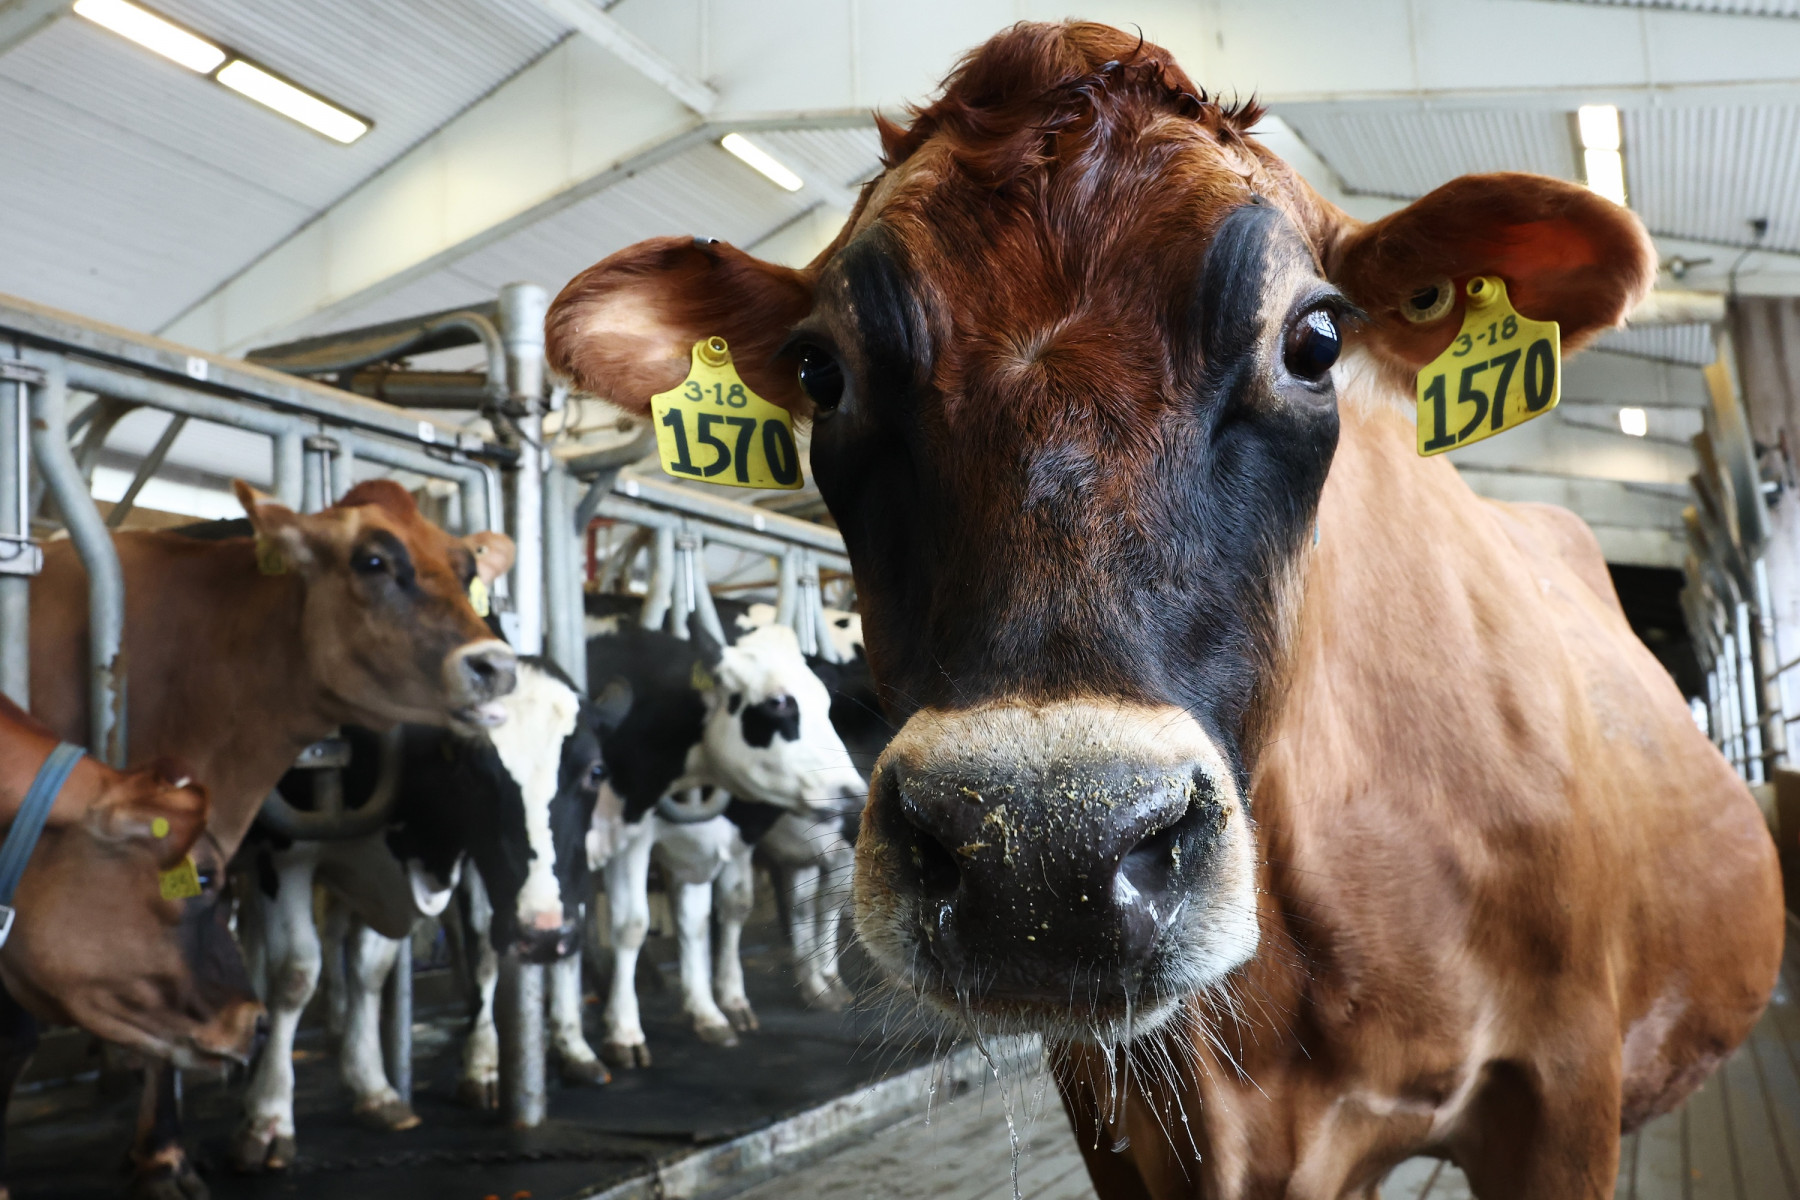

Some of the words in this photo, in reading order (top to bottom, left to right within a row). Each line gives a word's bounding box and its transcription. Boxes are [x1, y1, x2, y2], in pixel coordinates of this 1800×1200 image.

[1452, 314, 1518, 357] 3-18
[684, 381, 747, 408] 3-18
[1424, 338, 1555, 452] 1570
[662, 408, 798, 485] 1570
